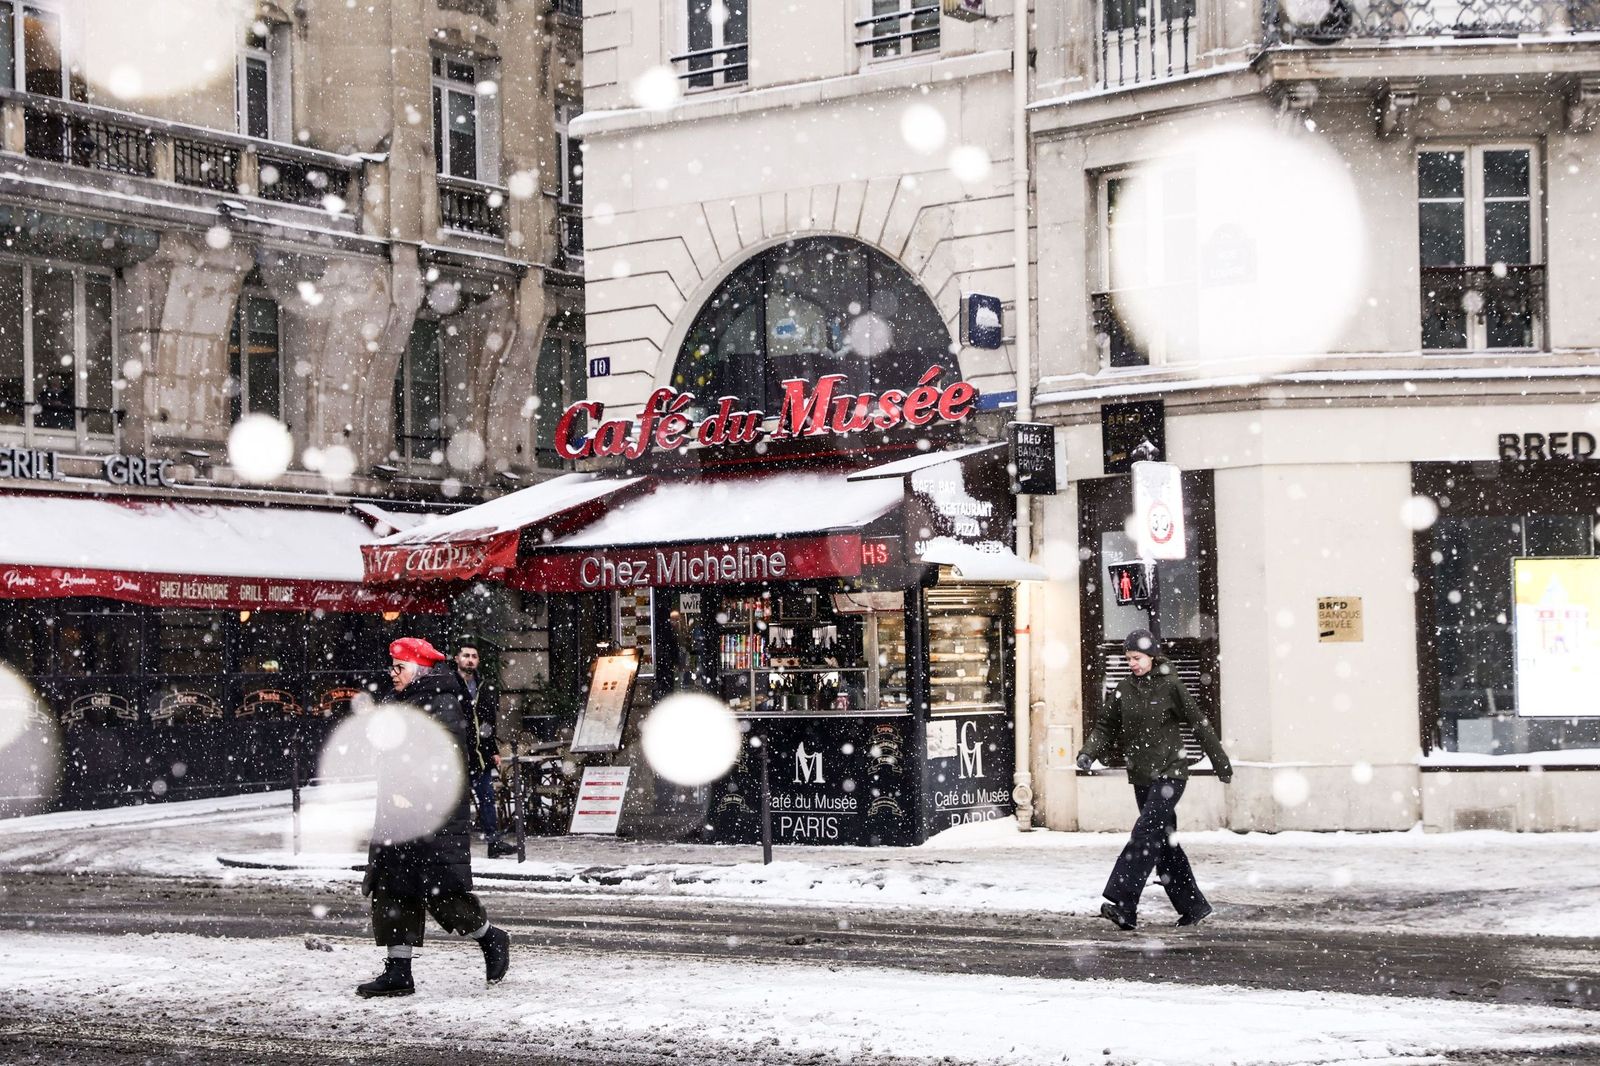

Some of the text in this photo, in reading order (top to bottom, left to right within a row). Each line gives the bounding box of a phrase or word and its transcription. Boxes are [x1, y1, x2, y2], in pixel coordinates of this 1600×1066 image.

[593, 360, 606, 375] 10
[555, 365, 978, 460] Café du Musée
[1018, 431, 1041, 445] BRED
[1498, 432, 1597, 460] BRED
[105, 454, 175, 487] GREC
[940, 501, 993, 517] RESTAURANT
[956, 522, 980, 537] PIZZA
[581, 546, 787, 588] Chez Micheline
[160, 580, 181, 599] CHEZ
[240, 584, 295, 602] GRILL HOUSE
[1318, 601, 1348, 610] BRED
[1319, 610, 1361, 620] BANQUE
[1319, 619, 1353, 629] PRIVÉE
[795, 793, 811, 809] du
[815, 792, 858, 809] Musée
[934, 788, 1010, 807] Café du Musée
[781, 816, 839, 838] PARIS
